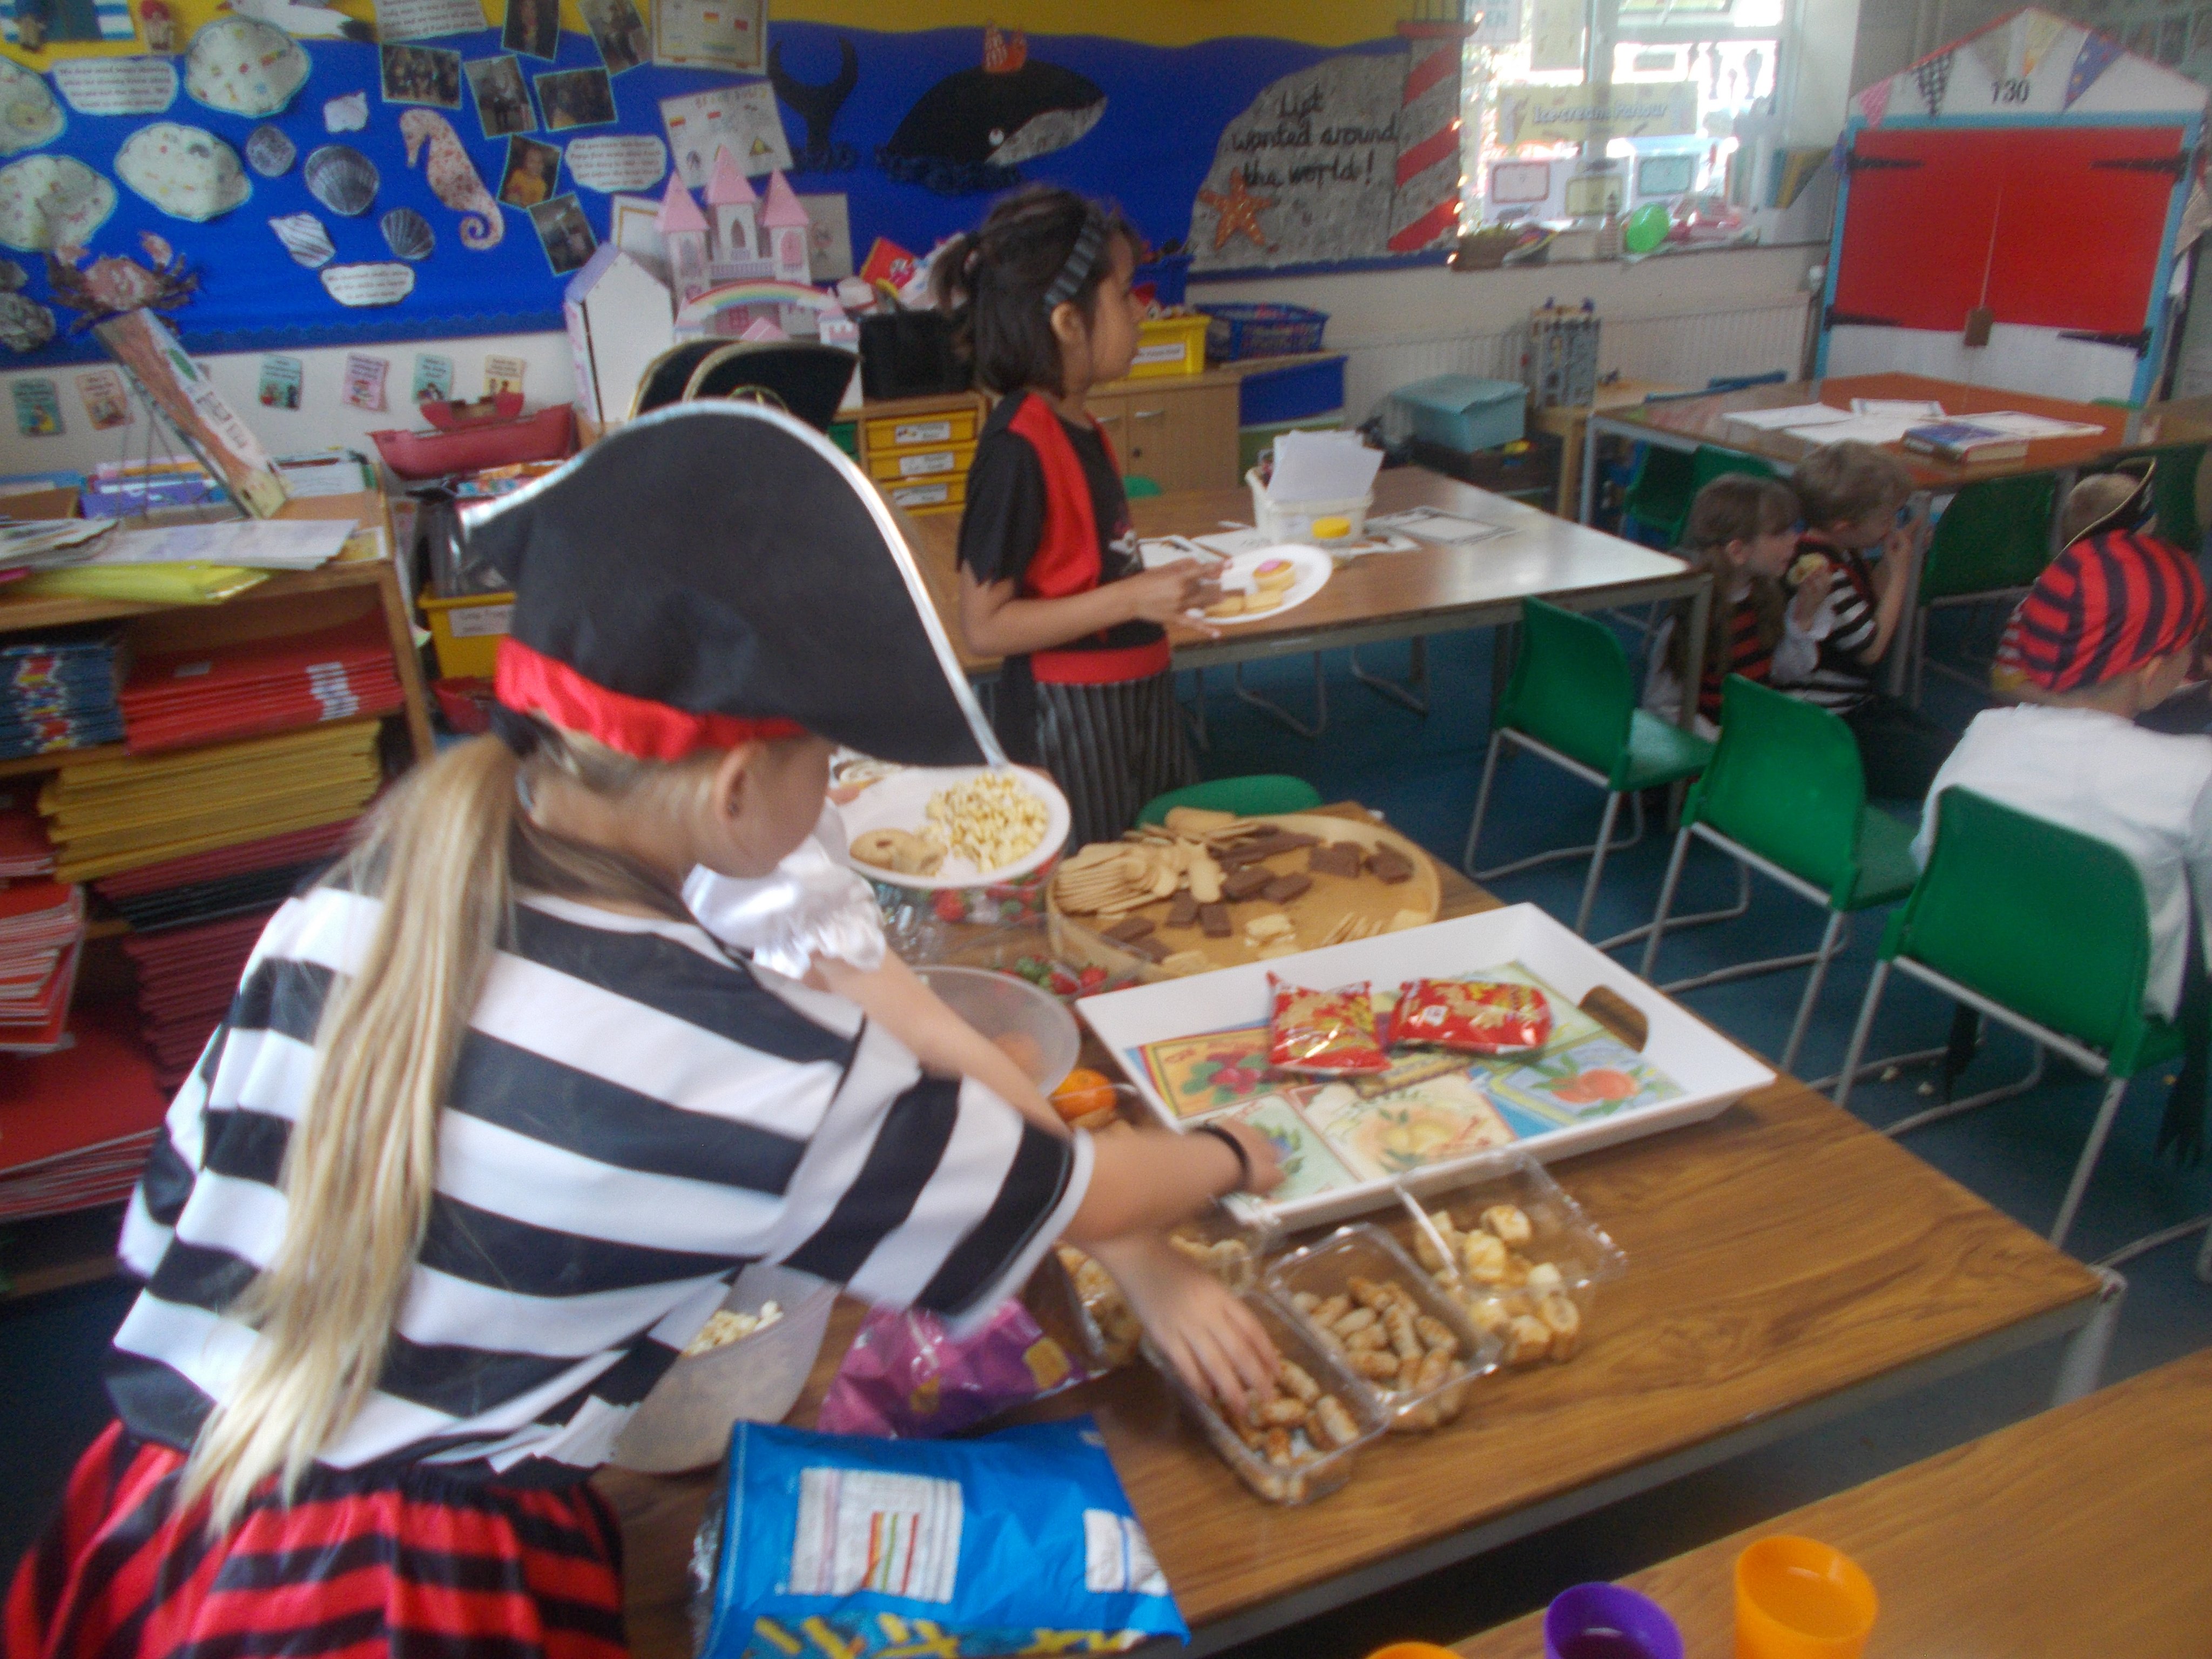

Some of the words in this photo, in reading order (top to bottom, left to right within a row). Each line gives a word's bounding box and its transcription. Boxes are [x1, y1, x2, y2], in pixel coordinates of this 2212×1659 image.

[1990, 79, 2031, 104] 130
[1233, 120, 1313, 152] wanted
[1321, 112, 1399, 146] around
[1243, 161, 1284, 187] the
